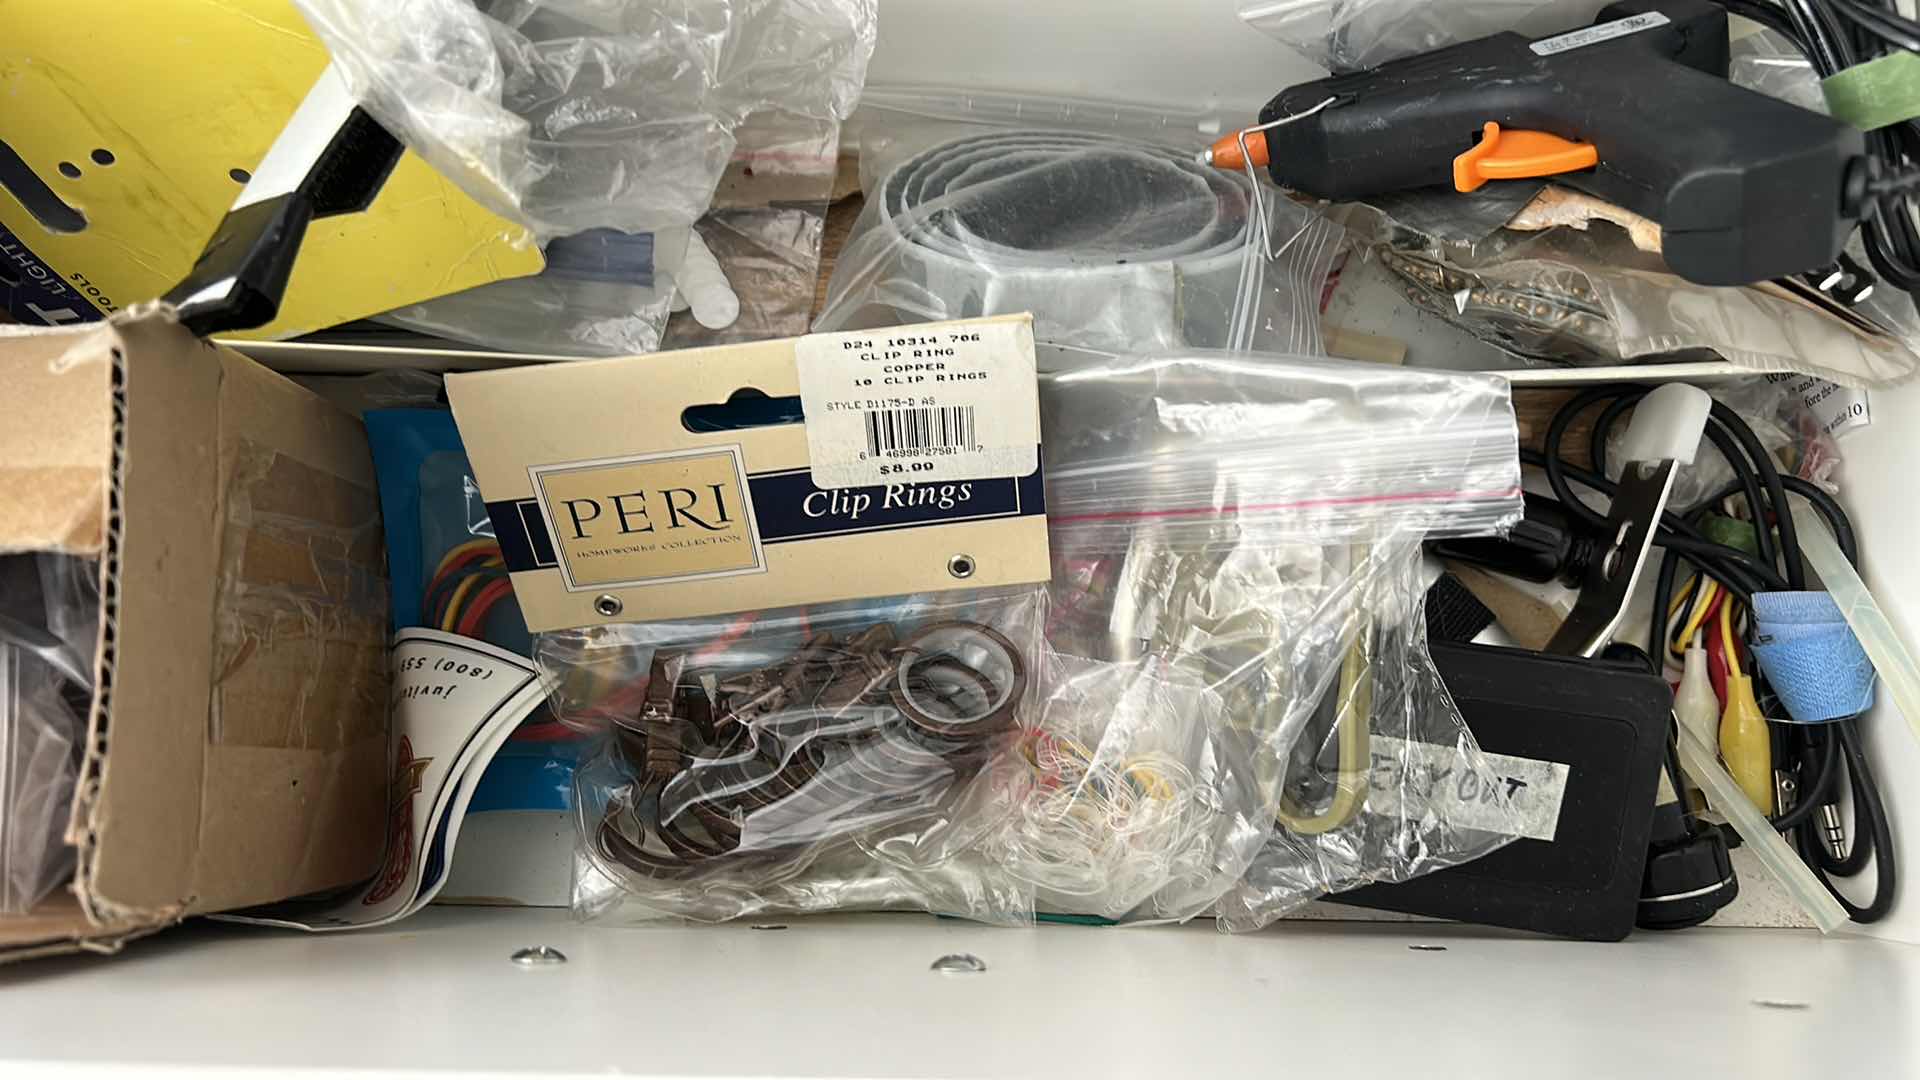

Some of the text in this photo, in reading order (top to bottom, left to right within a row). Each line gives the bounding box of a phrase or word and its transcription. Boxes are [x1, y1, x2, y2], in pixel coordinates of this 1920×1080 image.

[69, 273, 118, 313] TOOLS
[843, 341, 873, 350] D24
[888, 336, 937, 347] 10314
[860, 348, 955, 361] CLIP RING
[883, 362, 945, 373] COPPER
[855, 371, 987, 387] 10 CLIP RINGS
[826, 400, 861, 411] STYLE
[1848, 403, 1862, 417] 10
[803, 481, 972, 519] Clip Rings
[560, 482, 735, 540] PERI
[576, 535, 741, 559] HOMEWORKS COLLECTION
[434, 657, 493, 680] (800)
